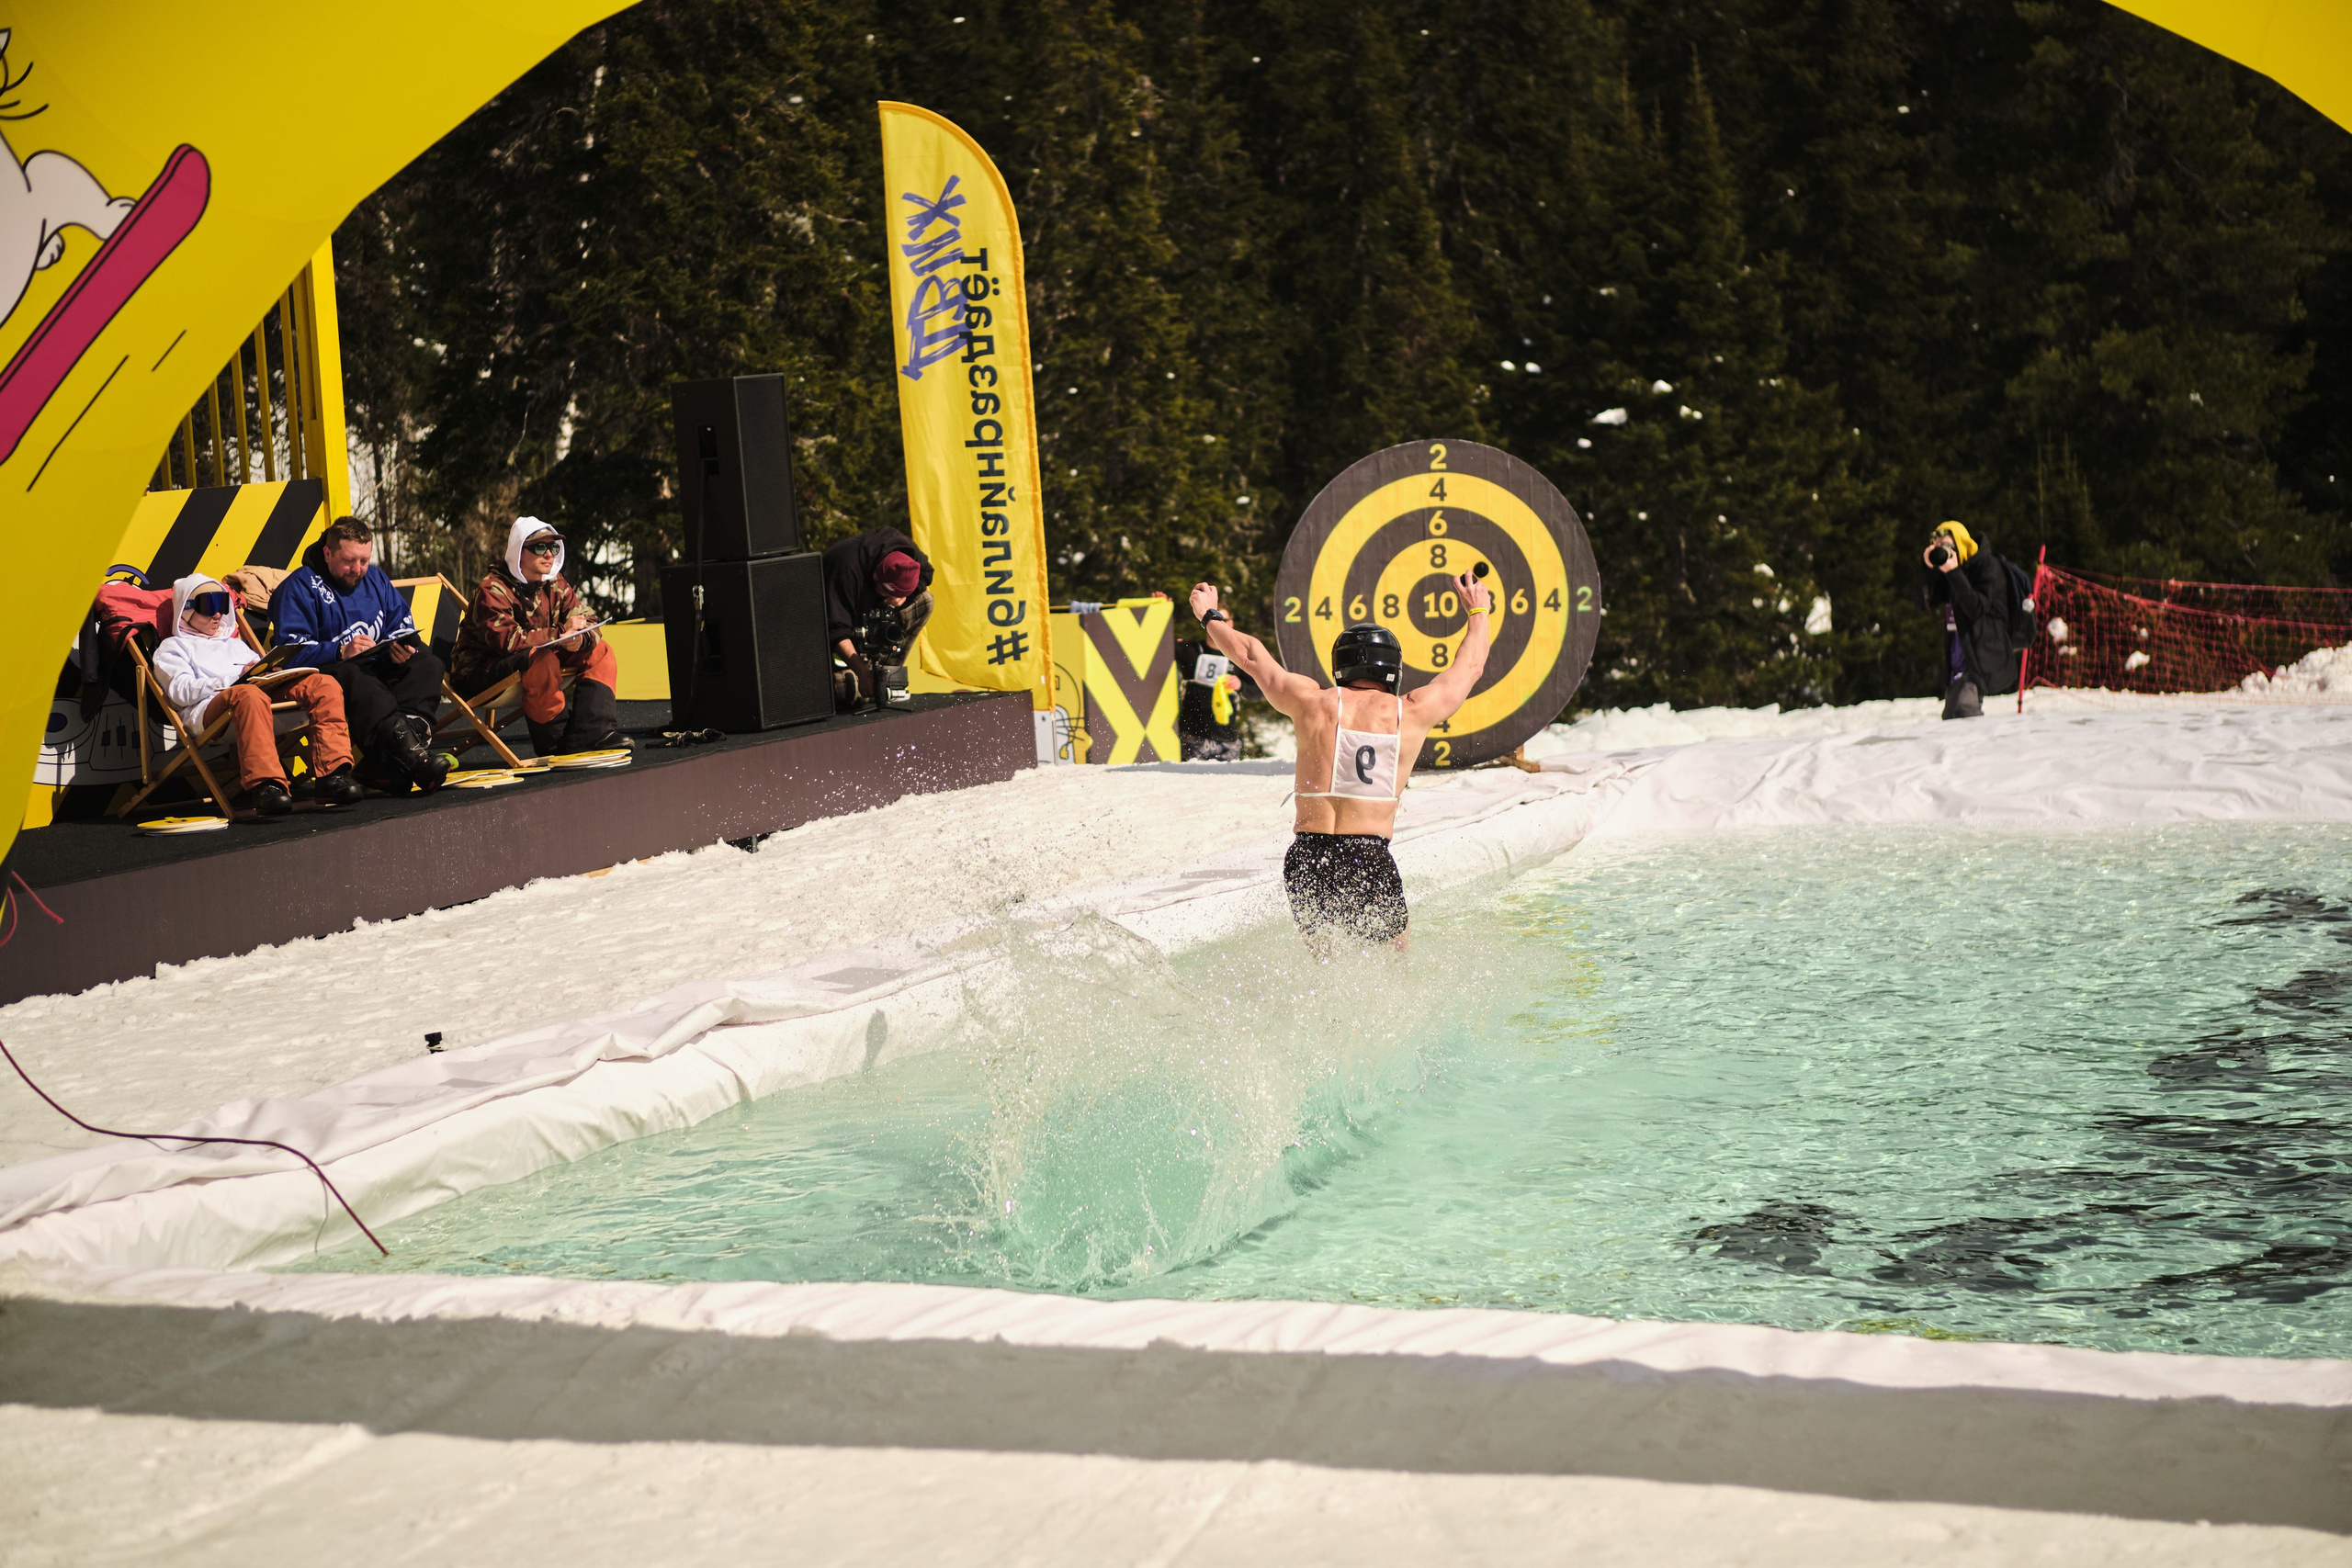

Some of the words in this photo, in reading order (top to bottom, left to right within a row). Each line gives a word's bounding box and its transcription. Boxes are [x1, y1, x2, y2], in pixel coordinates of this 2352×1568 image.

[1429, 444, 1447, 469] 2
[1429, 478, 1447, 502] 4
[1429, 511, 1447, 536] 6
[1430, 544, 1447, 569] 8
[1284, 597, 1301, 623] 2
[1315, 596, 1333, 621] 4
[1349, 594, 1367, 621] 6
[1383, 593, 1400, 618] 8
[1423, 592, 1458, 618] 10
[1510, 589, 1529, 615] 6
[1544, 588, 1561, 612] 4
[1576, 586, 1593, 612] 2
[1431, 643, 1448, 668] 8
[1206, 663, 1216, 679] 8
[1433, 741, 1451, 766] 2
